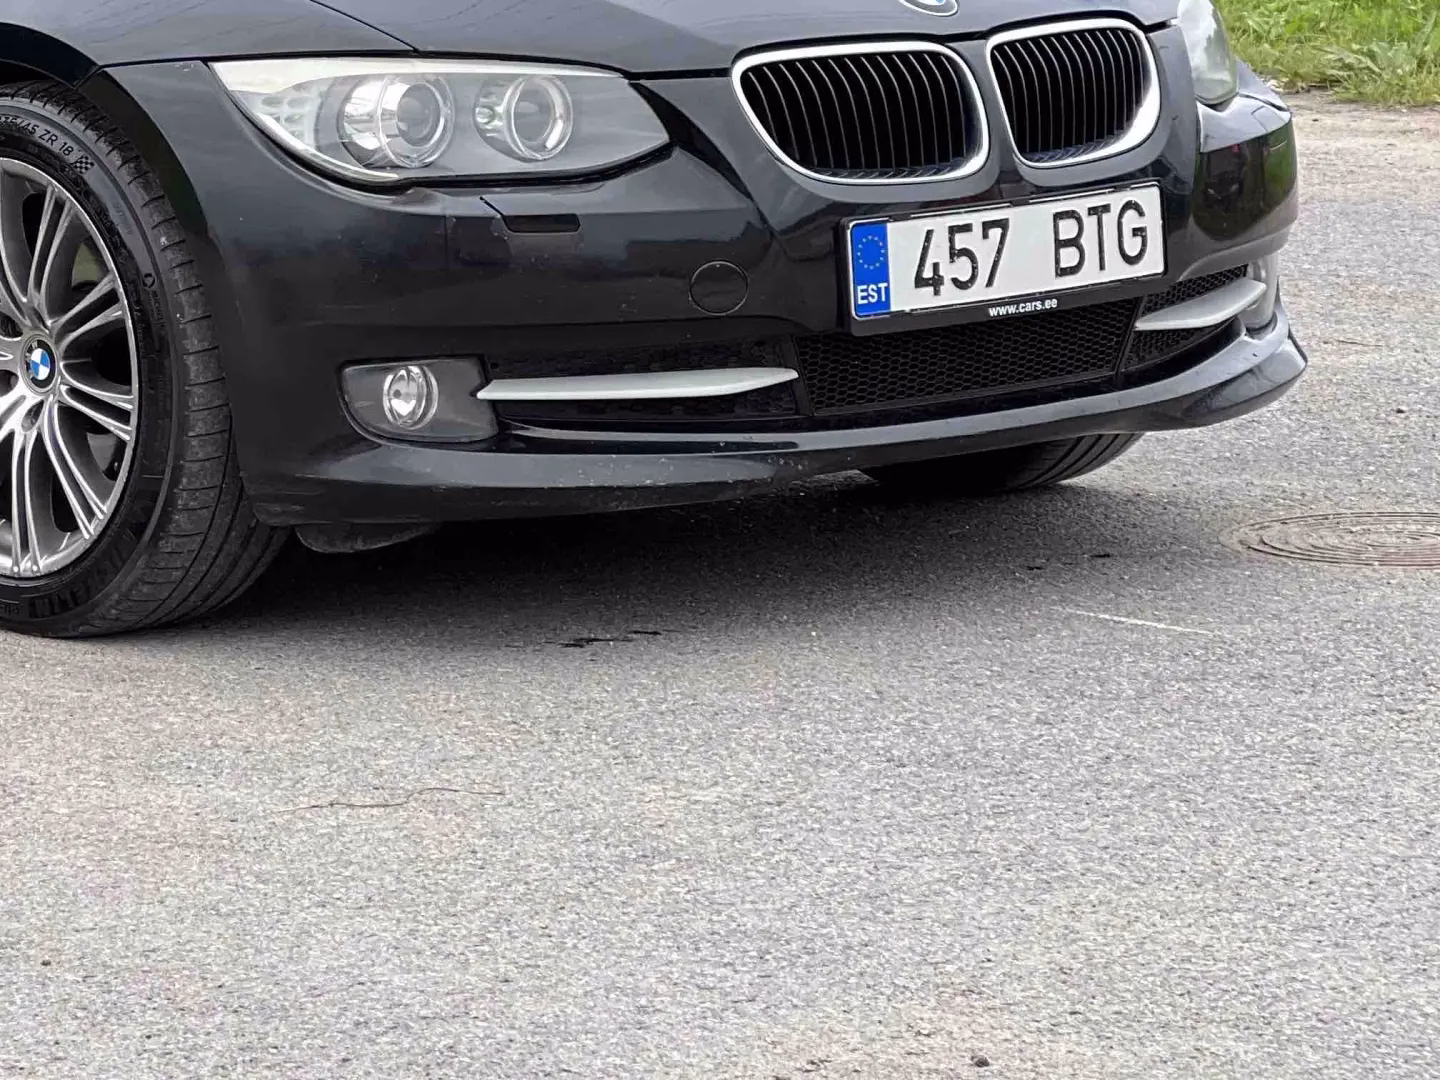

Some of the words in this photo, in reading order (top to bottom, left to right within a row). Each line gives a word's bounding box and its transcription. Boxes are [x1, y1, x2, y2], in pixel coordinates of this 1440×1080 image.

[38, 128, 58, 146] ZR
[58, 141, 74, 156] 18
[914, 218, 1009, 296] 457
[1053, 199, 1148, 278] BTG
[857, 282, 888, 304] EST
[988, 297, 1058, 318] www.cars.ee
